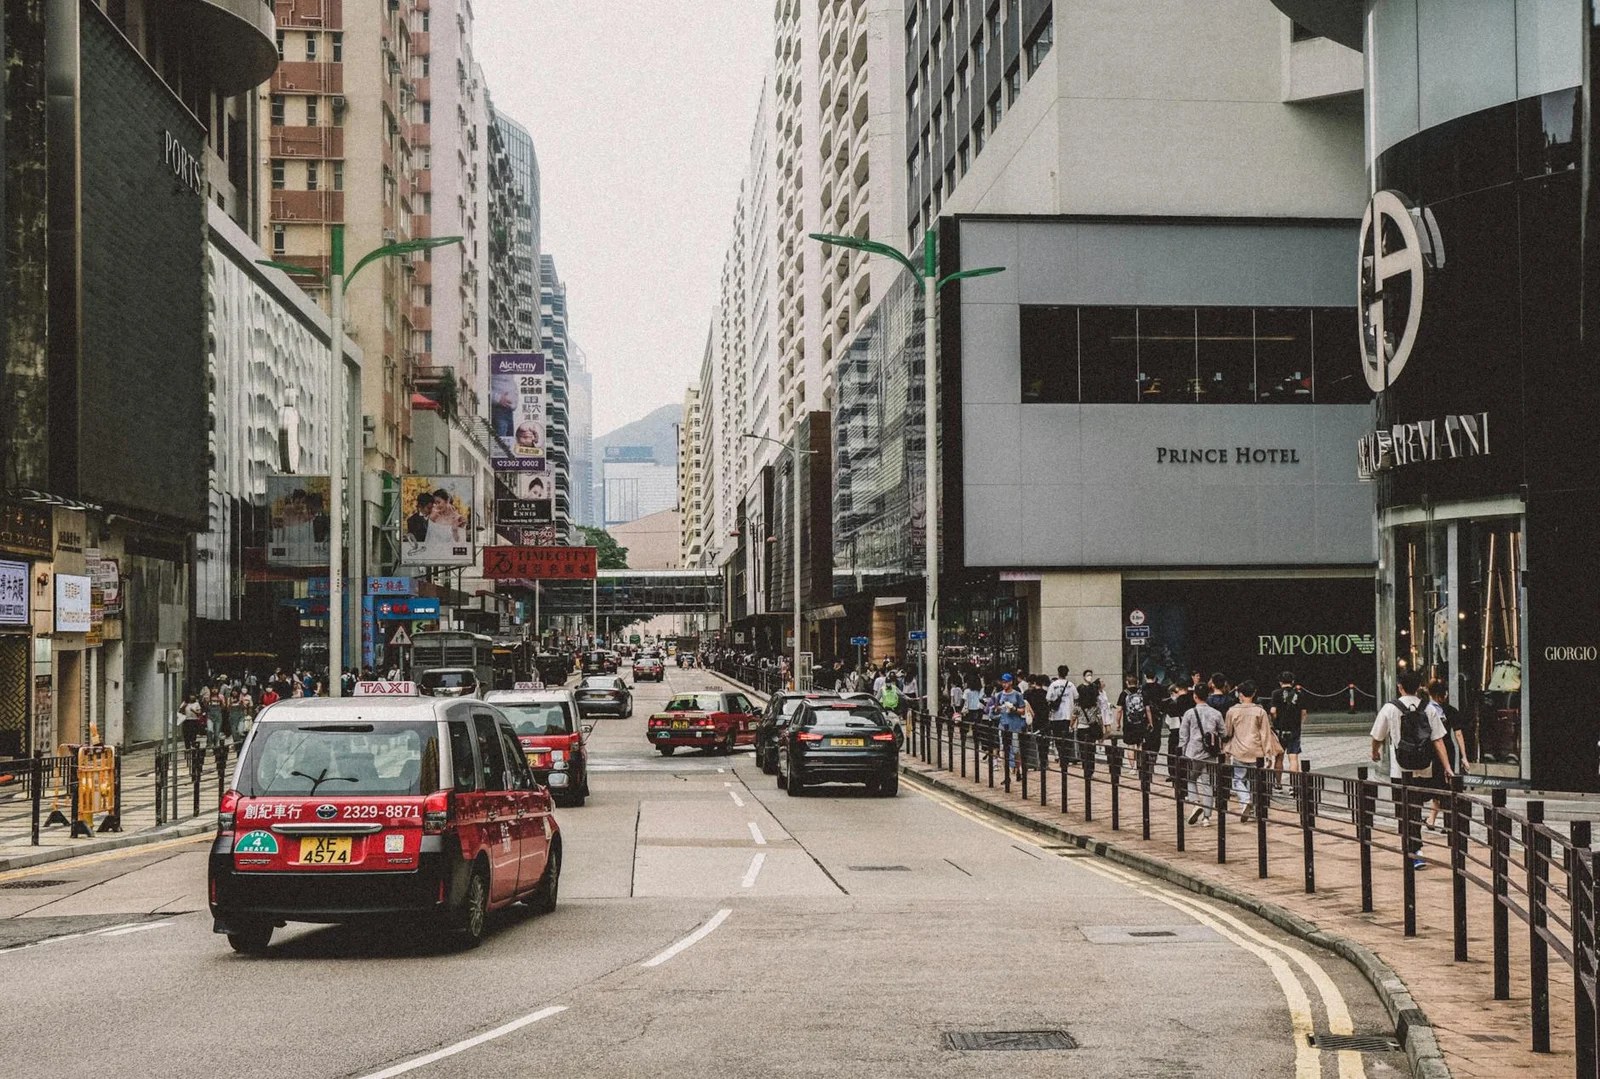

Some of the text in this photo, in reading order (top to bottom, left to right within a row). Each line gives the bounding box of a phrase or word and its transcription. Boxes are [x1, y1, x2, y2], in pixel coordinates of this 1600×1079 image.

[165, 129, 201, 195] PORTS
[499, 361, 537, 372] Alchemy
[1258, 634, 1352, 655] EMPORIO
[1545, 646, 1597, 661] GIORGIO
[360, 682, 410, 694] TAXI
[243, 803, 303, 819] 創紀車行
[343, 805, 420, 819] 2329-8871
[252, 838, 262, 846] 4
[315, 837, 337, 851] XF
[303, 850, 347, 863] 4574
